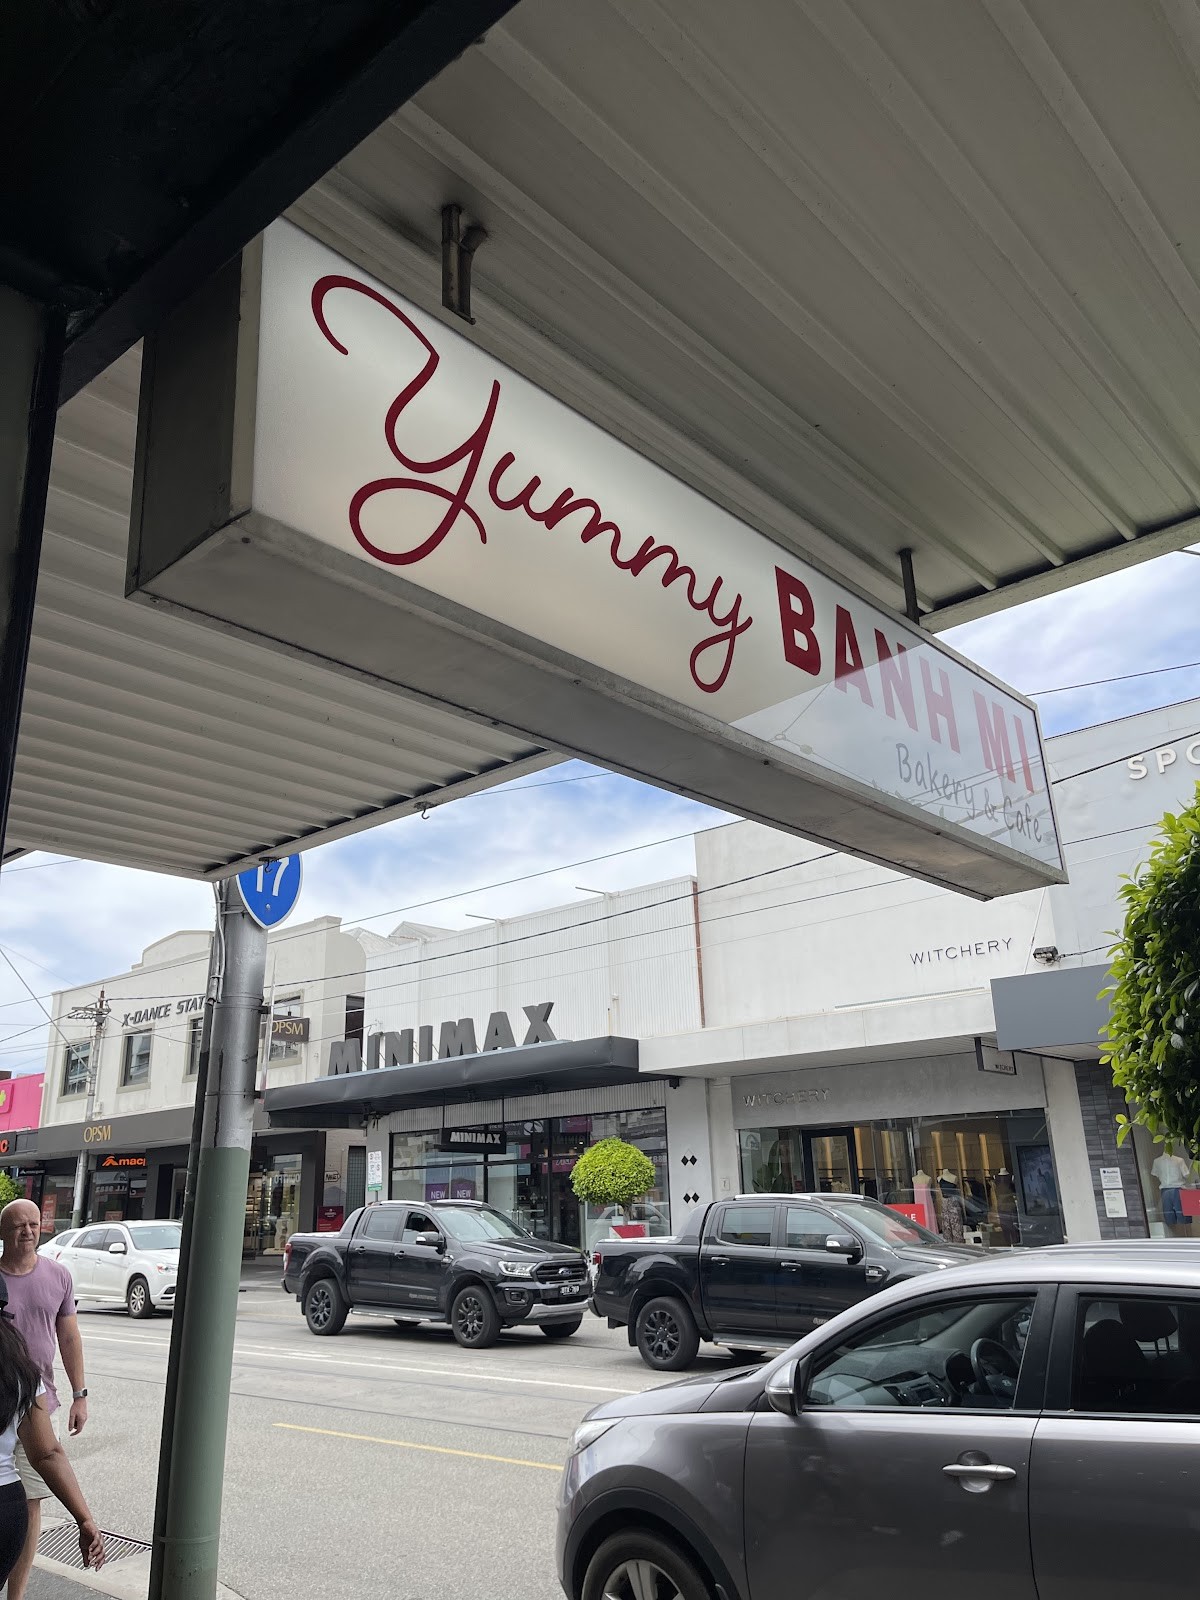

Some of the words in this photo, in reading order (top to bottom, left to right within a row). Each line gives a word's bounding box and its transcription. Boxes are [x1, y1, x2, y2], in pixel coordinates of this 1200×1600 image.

[311, 274, 753, 693] Yummy
[775, 565, 960, 754] BANH
[972, 689, 1034, 794] MI
[895, 743, 976, 820] Bakery
[984, 787, 998, 822] &
[1003, 796, 1042, 843] Cafe
[256, 857, 289, 897] 17
[910, 937, 1012, 965] WITCHERY
[122, 1003, 172, 1027] X-DANCE
[176, 996, 206, 1015] STAT
[272, 1021, 304, 1036] OPSM
[328, 1002, 557, 1076] MINIMAX
[743, 1088, 830, 1107] WITCHERY
[83, 1125, 111, 1142] OPSM
[450, 1131, 501, 1144] MINIMAX
[430, 1191, 446, 1199] NEW
[457, 1190, 471, 1198] NEW
